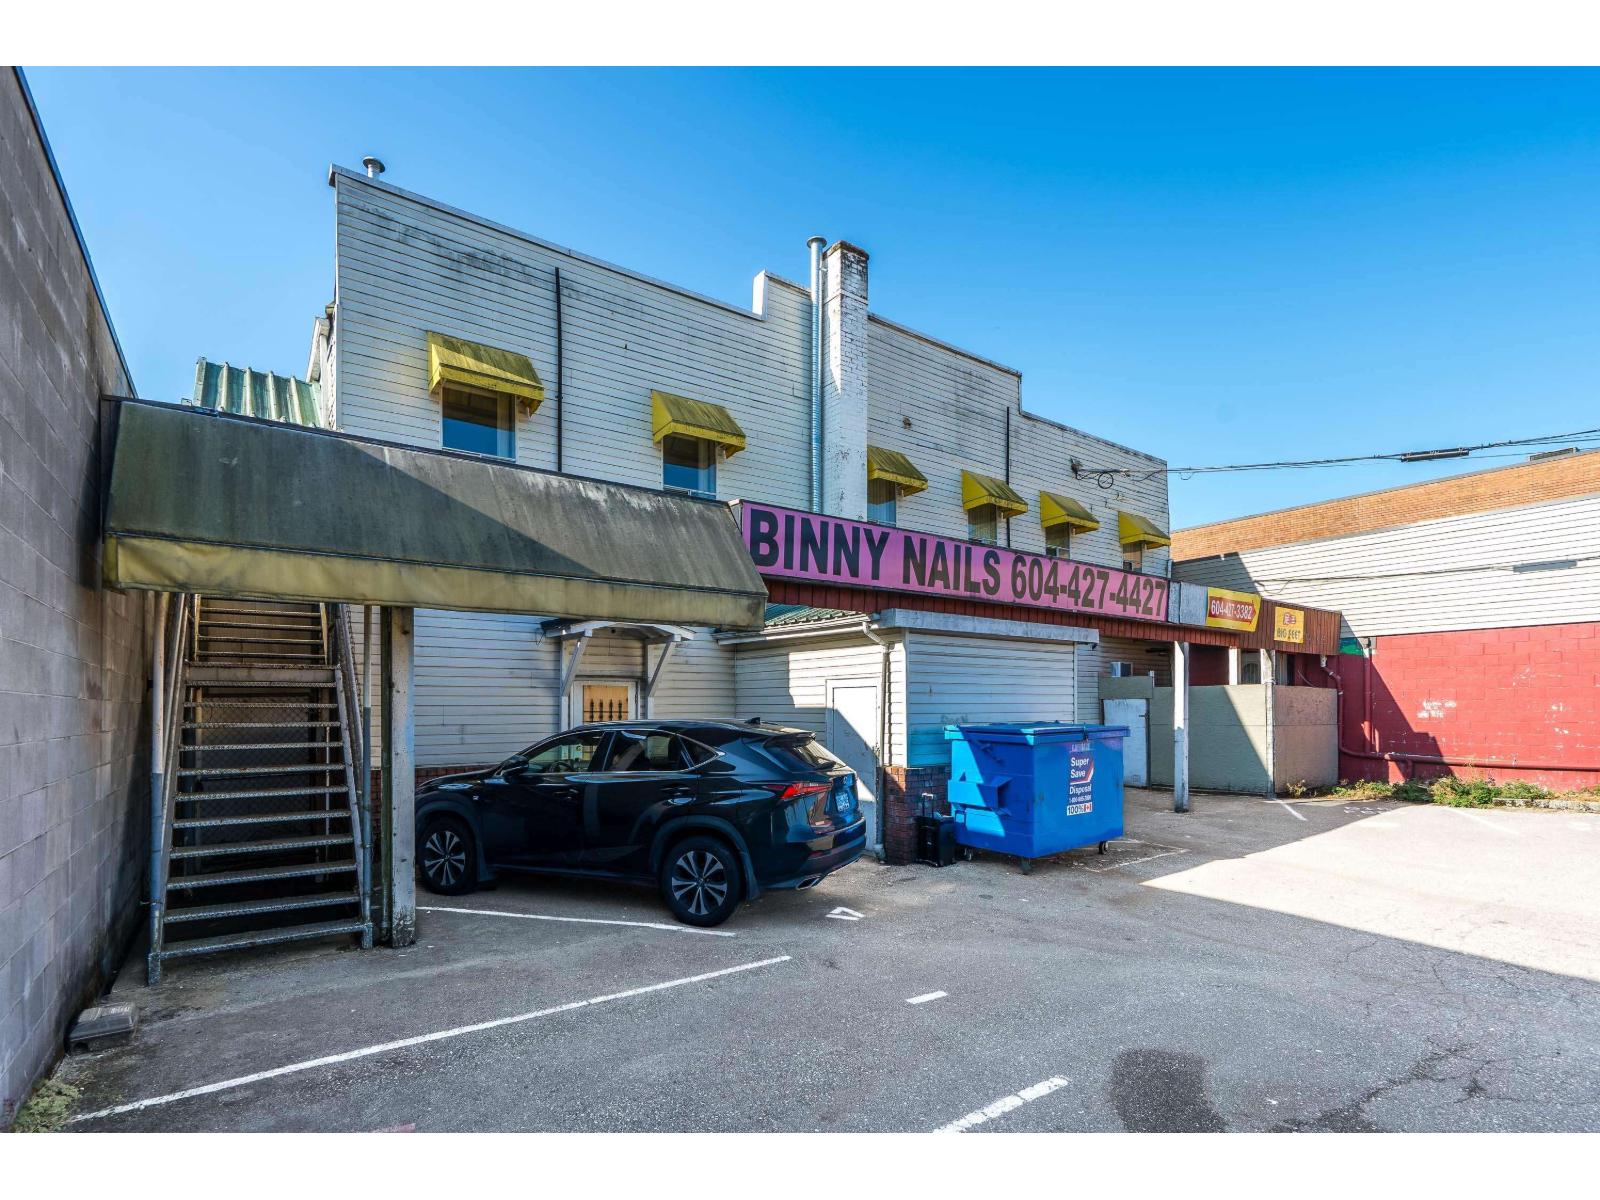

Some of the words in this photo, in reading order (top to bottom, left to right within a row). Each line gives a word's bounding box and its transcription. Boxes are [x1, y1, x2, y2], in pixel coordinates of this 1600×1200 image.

[750, 508, 890, 580] BINNY
[903, 535, 1000, 595] NAILS
[1011, 555, 1167, 616] 604-427-4427
[1211, 600, 1253, 619] 604-427-3382
[1071, 757, 1089, 768] Super
[1071, 769, 1086, 778] Save
[1069, 784, 1092, 795] Disposal
